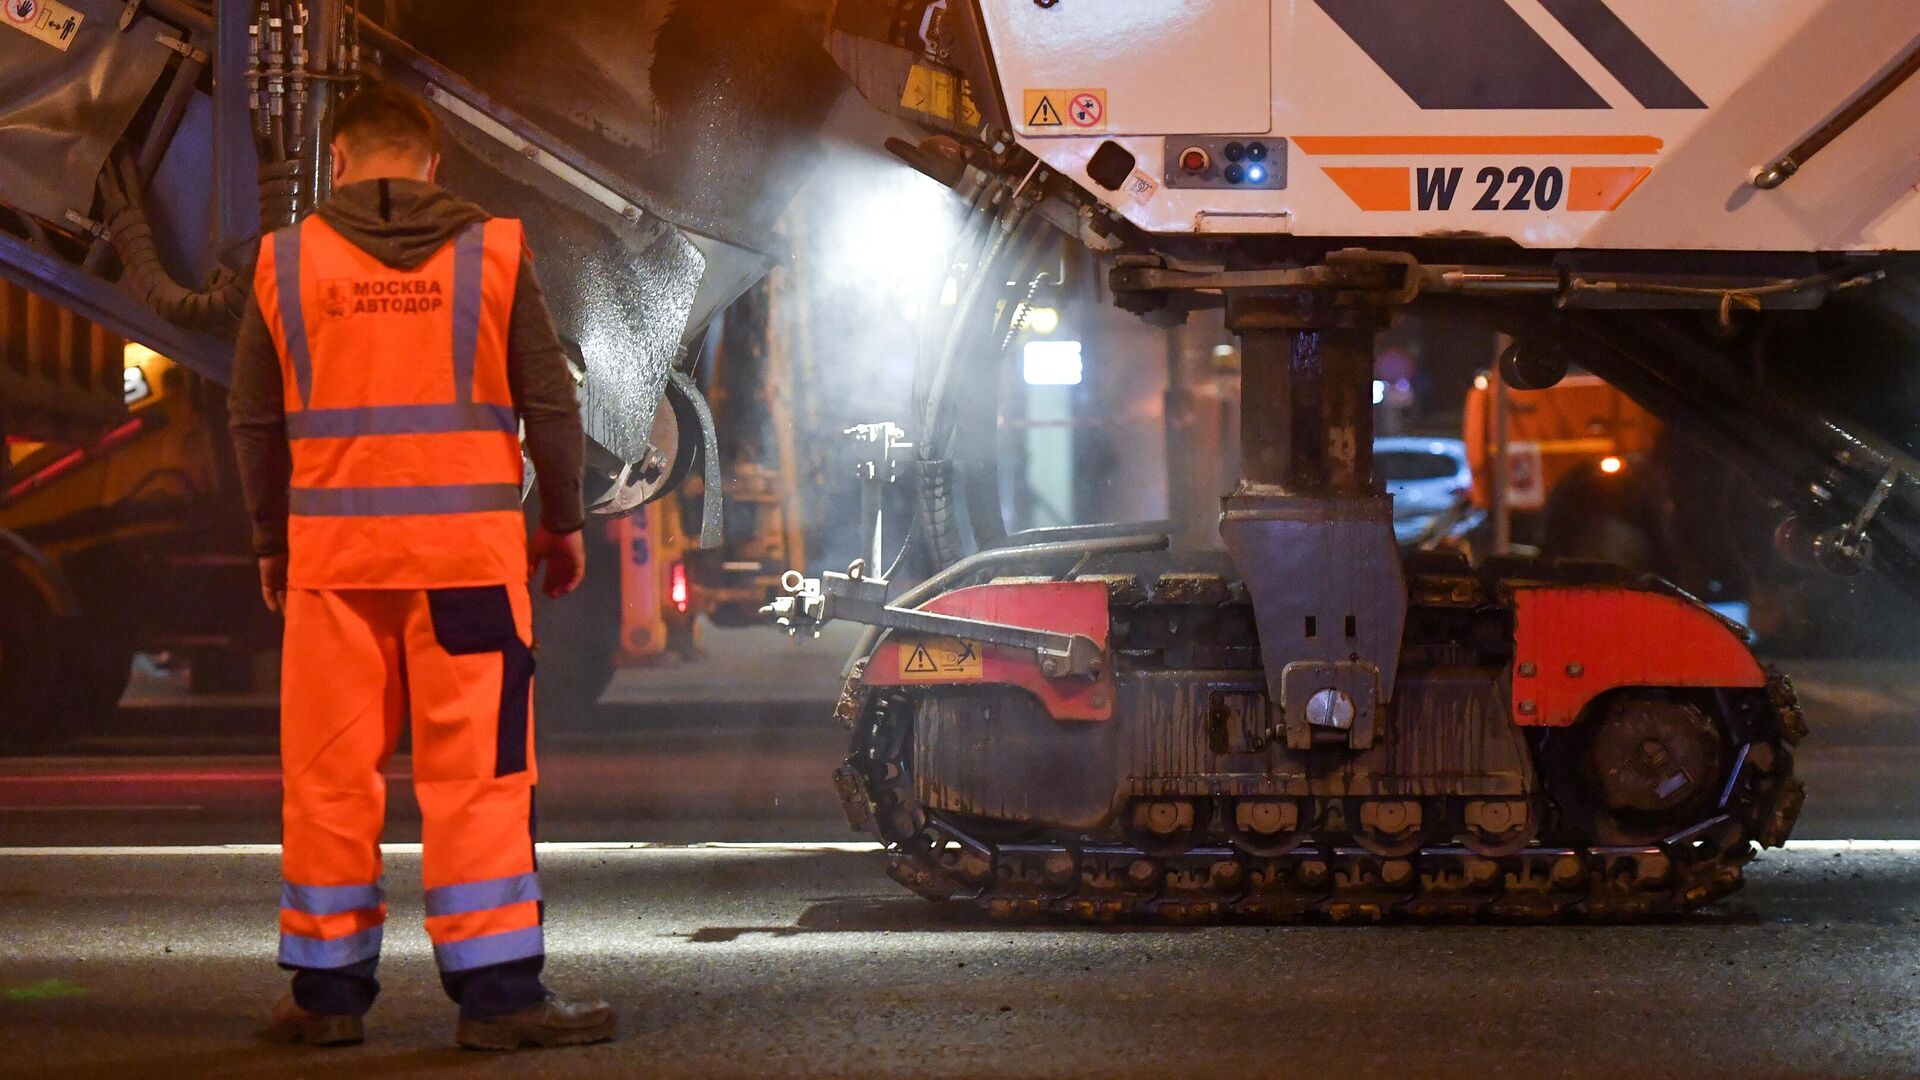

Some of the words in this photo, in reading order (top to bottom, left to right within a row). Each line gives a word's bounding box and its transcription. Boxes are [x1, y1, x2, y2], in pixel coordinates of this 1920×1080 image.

[1416, 167, 1464, 211] W
[1471, 166, 1563, 211] 220
[353, 280, 442, 296] МОСКВА
[353, 297, 443, 314] АВТОДОР
